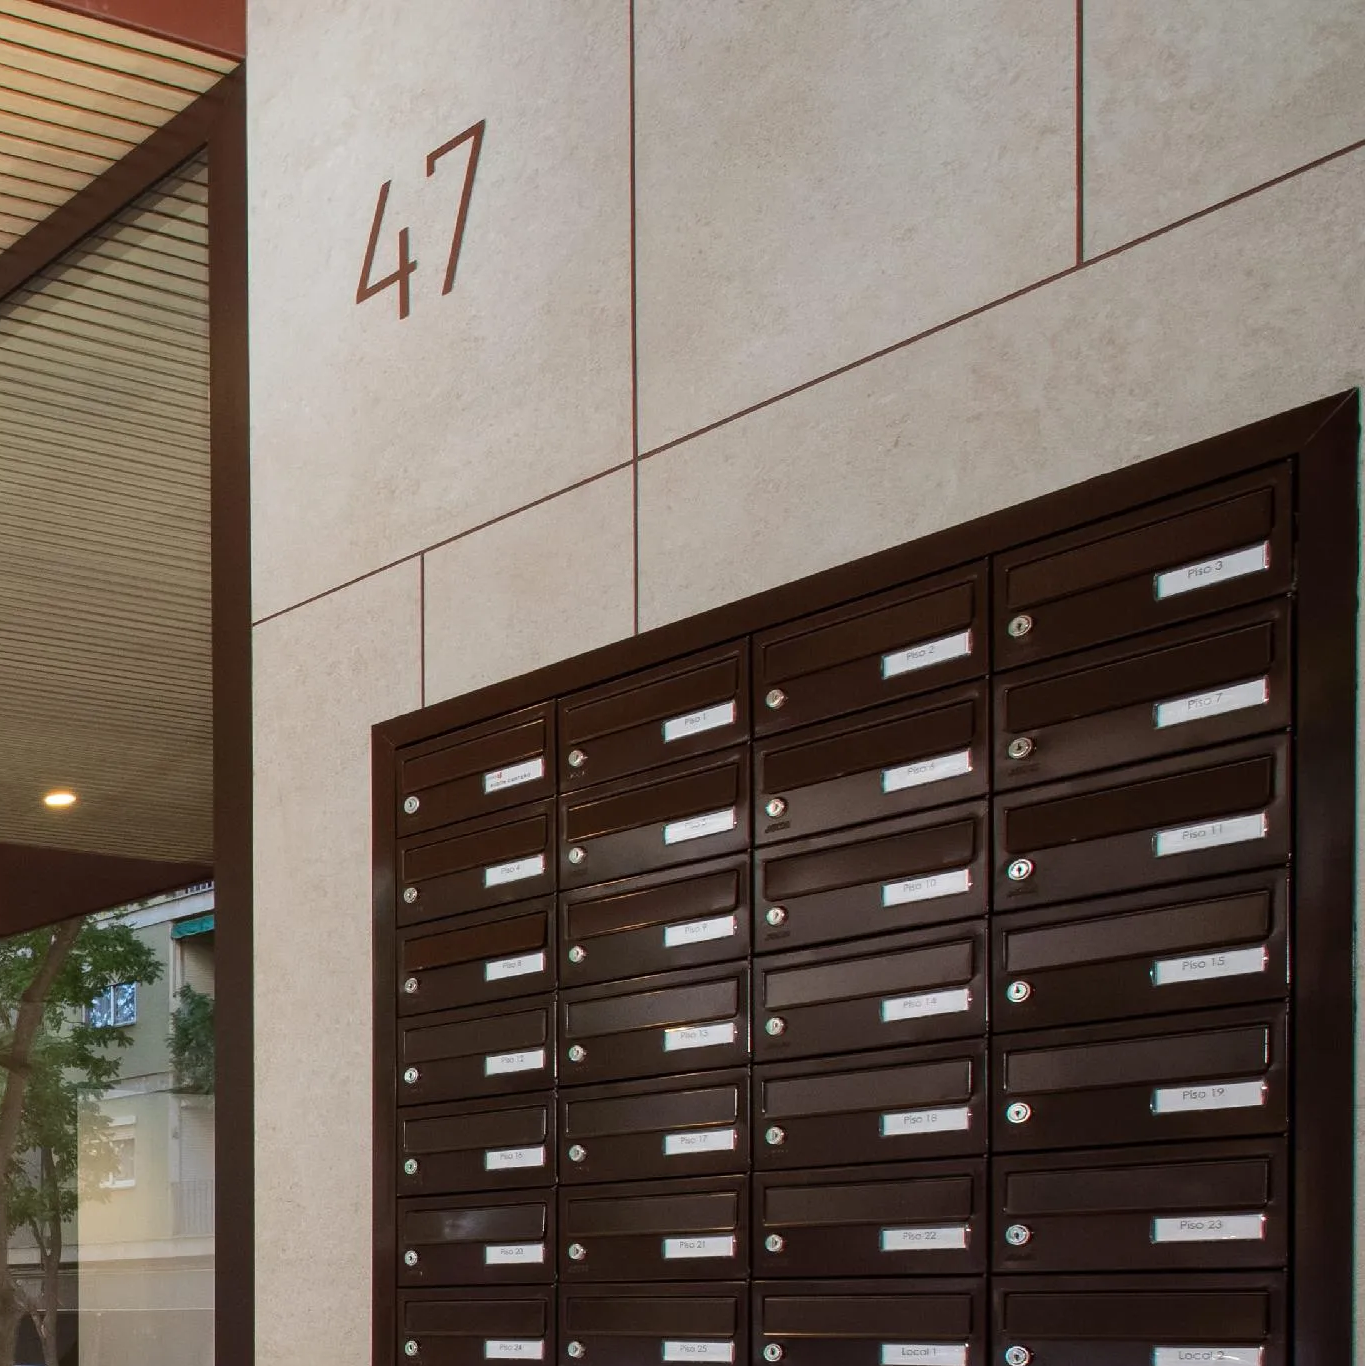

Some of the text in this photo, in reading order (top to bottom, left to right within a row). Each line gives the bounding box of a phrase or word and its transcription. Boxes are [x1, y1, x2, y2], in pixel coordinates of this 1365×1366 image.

[355, 118, 486, 320] 47
[1187, 565, 1212, 579] Piso
[905, 649, 926, 661] Piso
[1187, 696, 1212, 710] Piso
[1182, 828, 1207, 841] Piso
[903, 882, 922, 893] Piso
[1181, 958, 1206, 971] Piso
[903, 999, 922, 1009] Piso
[1182, 1089, 1206, 1100] Piso
[903, 1113, 923, 1125] Piso
[680, 1136, 696, 1145] Piso
[1179, 1219, 1204, 1230] Piso
[902, 1230, 922, 1241] Piso
[679, 1240, 695, 1249] Piso
[901, 1347, 929, 1356] Local
[1177, 1350, 1213, 1361] Local
